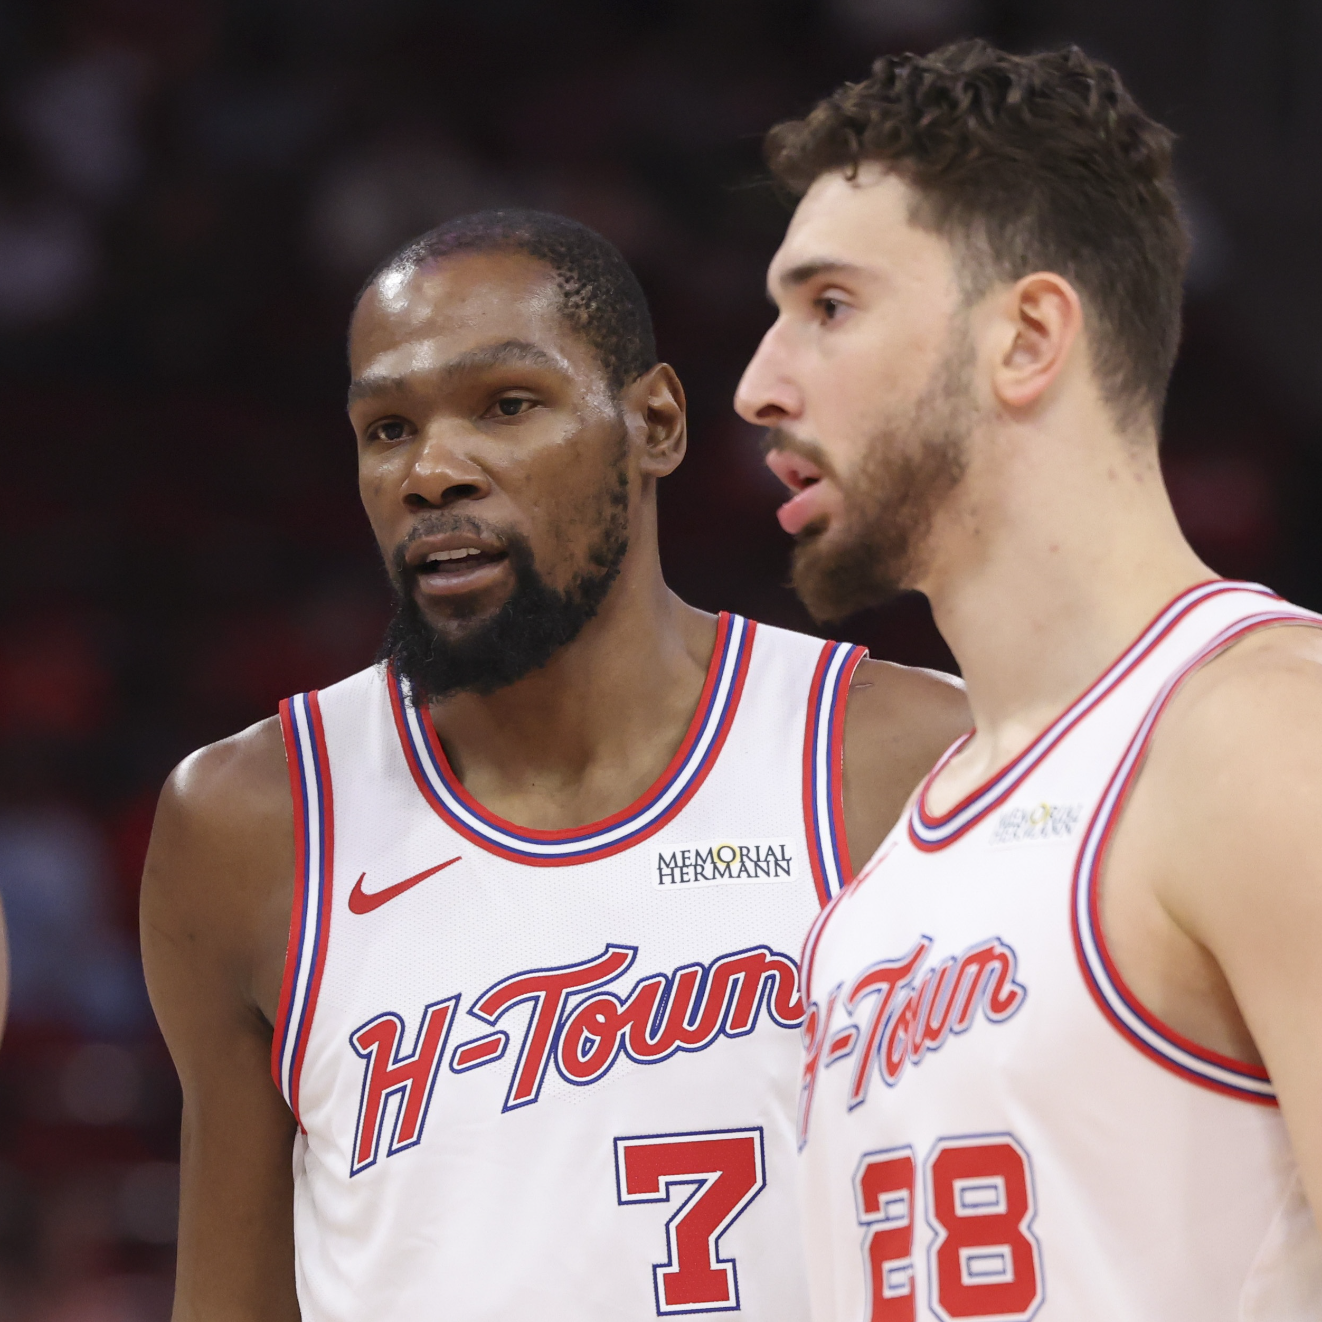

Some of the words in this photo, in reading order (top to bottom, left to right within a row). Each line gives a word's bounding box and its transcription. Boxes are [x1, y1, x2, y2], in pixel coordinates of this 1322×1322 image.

[657, 844, 792, 870] MEMORIAL
[658, 860, 791, 885] HERMANN
[349, 943, 807, 1178] H-Town
[614, 1126, 767, 1317] 7
